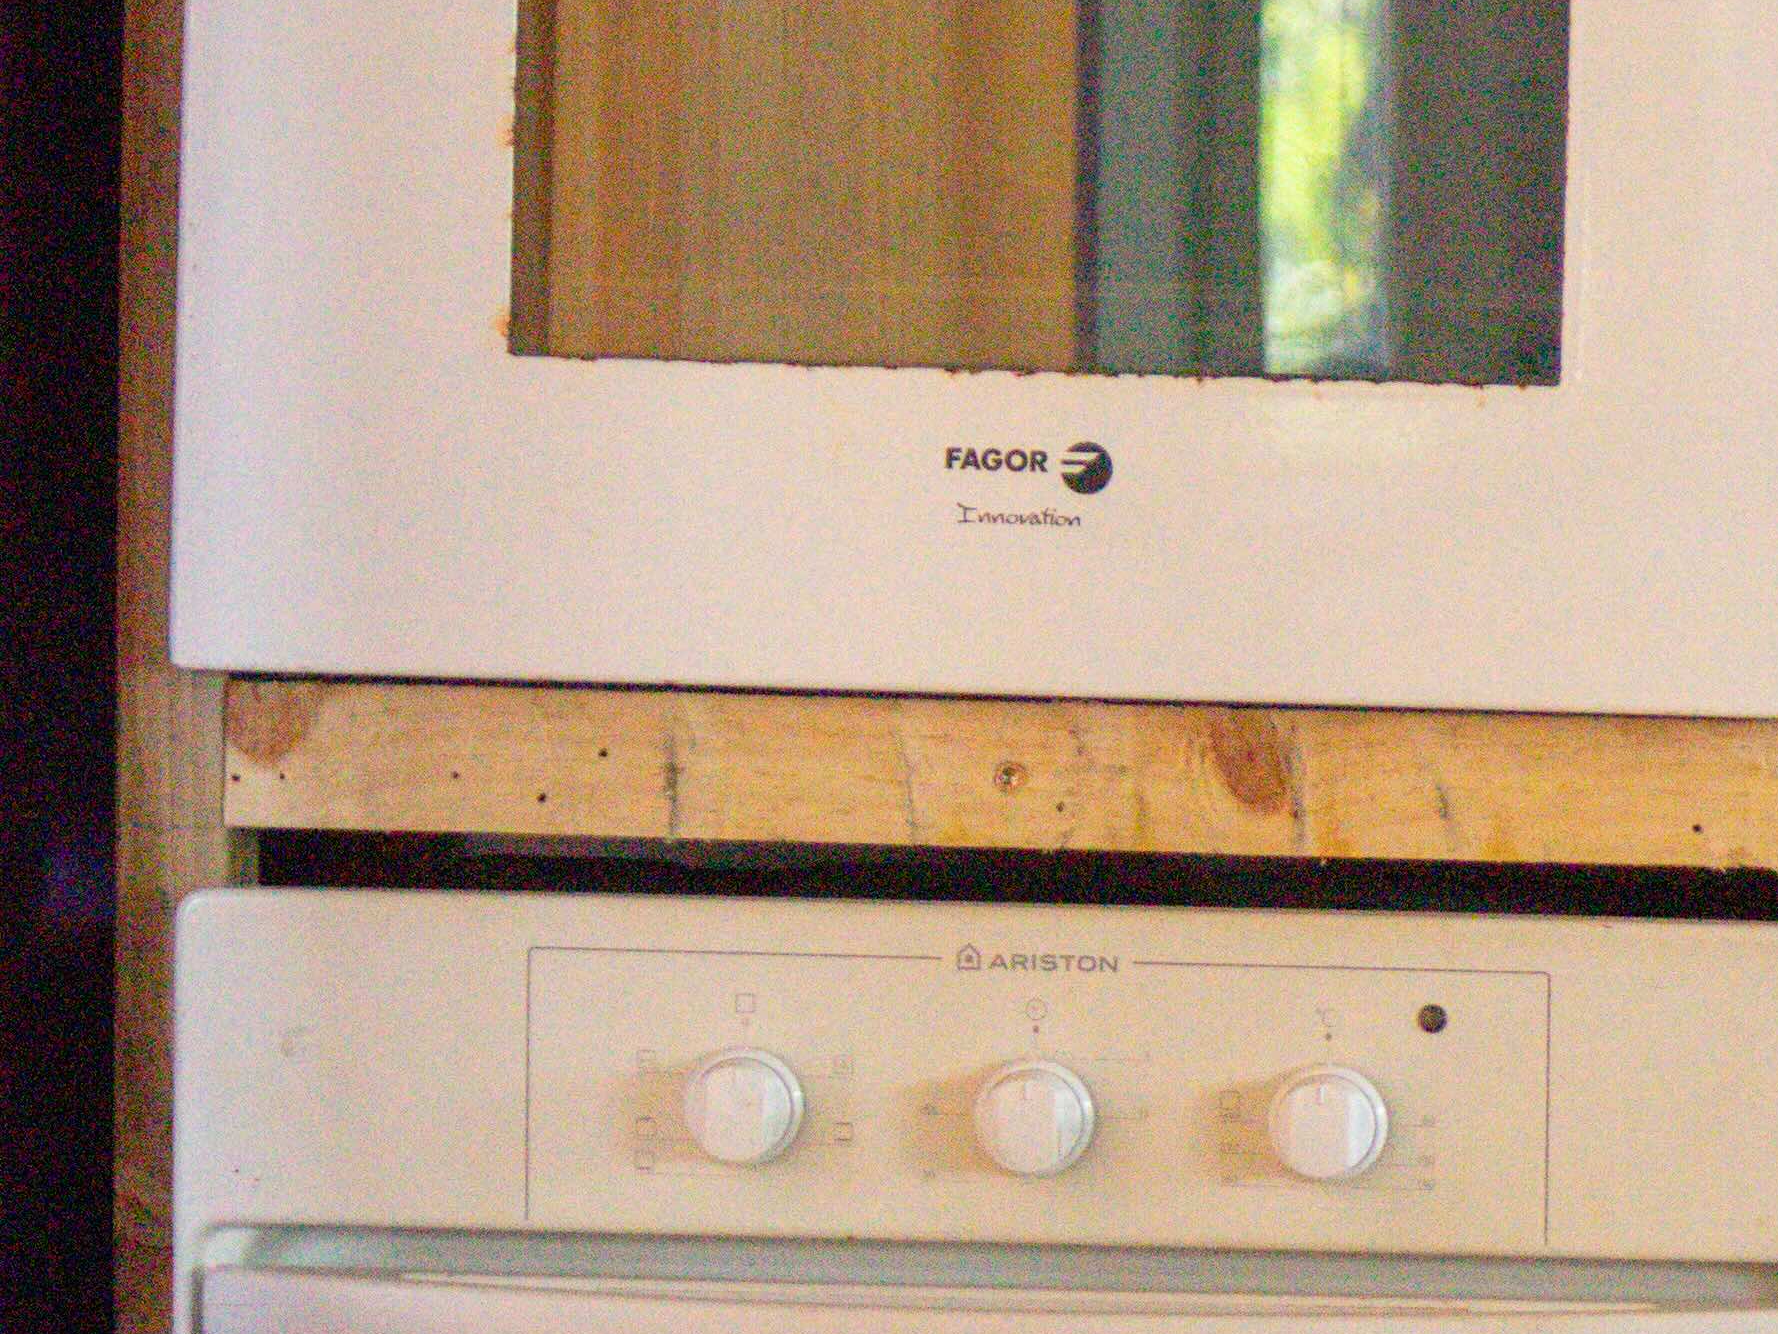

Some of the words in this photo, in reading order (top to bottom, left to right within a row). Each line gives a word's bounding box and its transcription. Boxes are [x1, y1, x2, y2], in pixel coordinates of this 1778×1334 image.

[944, 446, 1048, 473] FAGOR
[956, 501, 1082, 527] Innovation
[988, 953, 1120, 973] ARISTON
